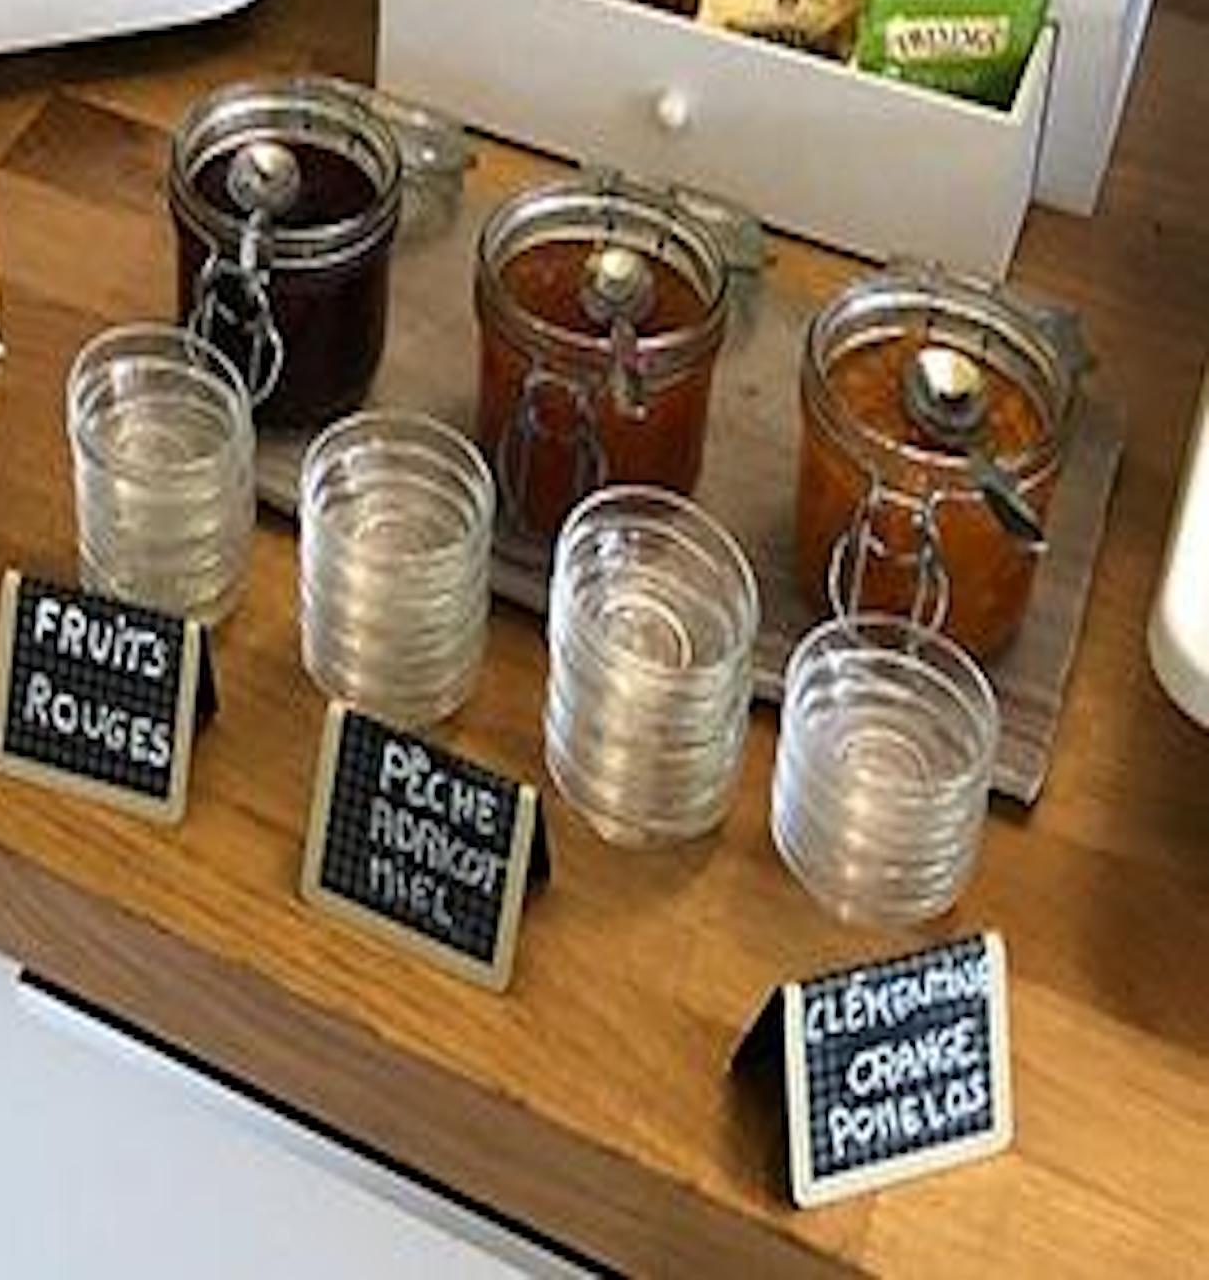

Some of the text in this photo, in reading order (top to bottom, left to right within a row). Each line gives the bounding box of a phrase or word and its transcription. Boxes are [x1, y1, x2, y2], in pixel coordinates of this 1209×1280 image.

[23, 672, 171, 768] ROUGES
[846, 1017, 980, 1095] ORANGE
[828, 1074, 989, 1160] POMELOS
